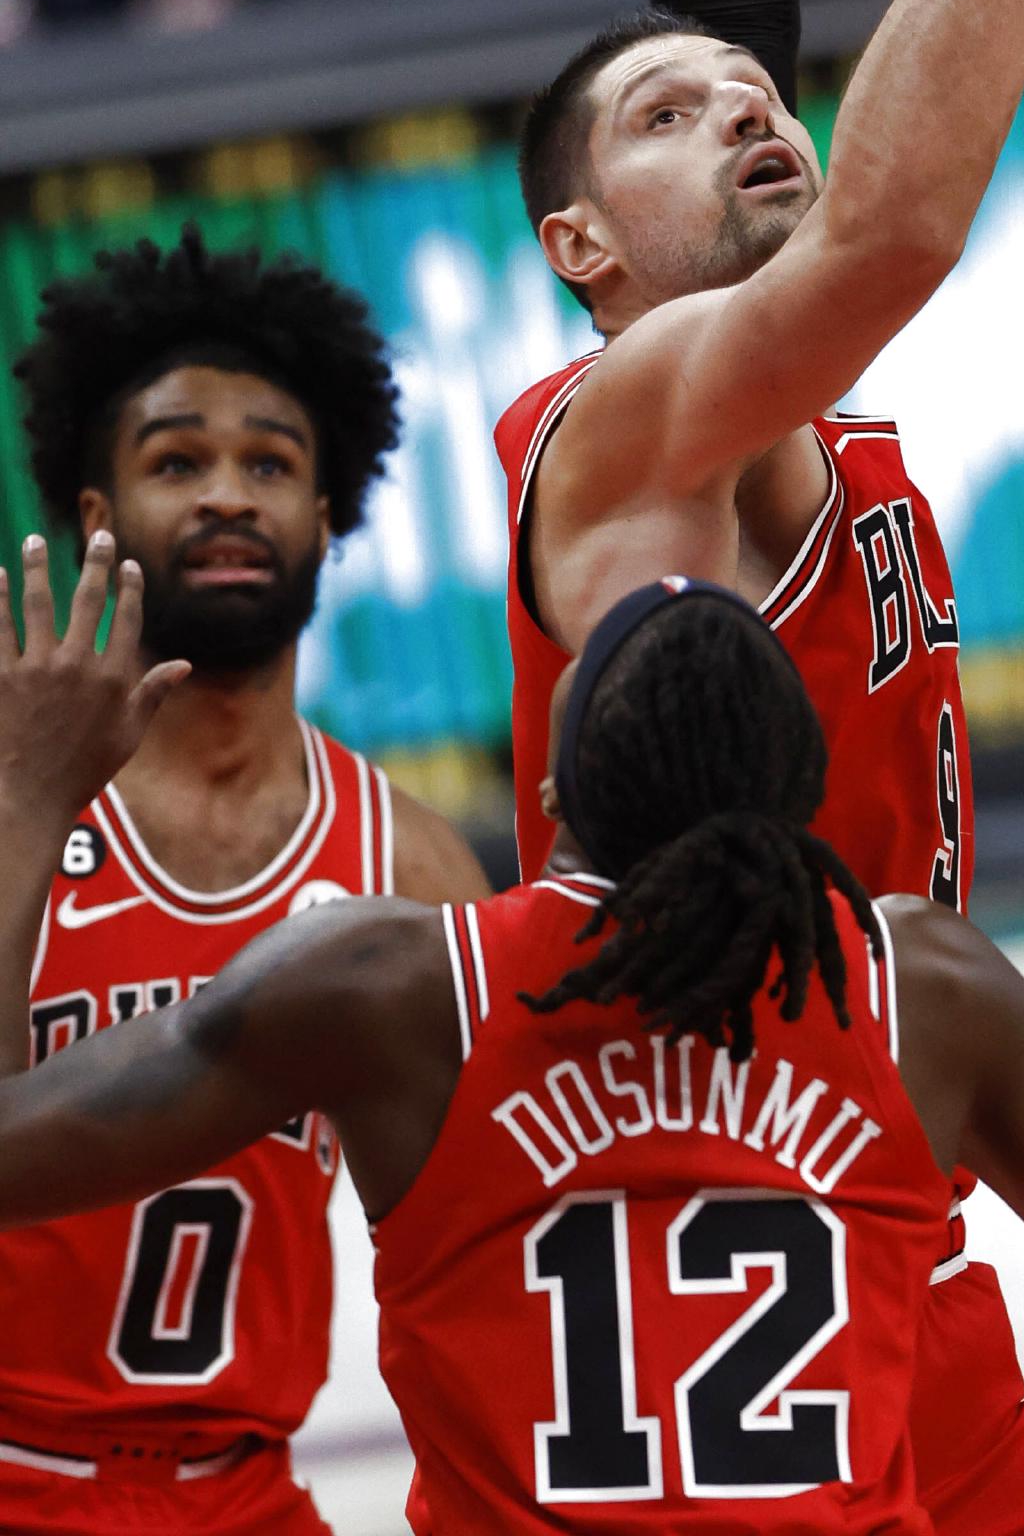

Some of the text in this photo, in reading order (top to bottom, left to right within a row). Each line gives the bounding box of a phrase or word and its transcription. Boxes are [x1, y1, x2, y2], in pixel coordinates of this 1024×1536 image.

[62, 829, 96, 875] 6
[491, 1035, 882, 1195] DOSUNMU
[107, 1177, 255, 1385] 0
[523, 1188, 853, 1504] 12
